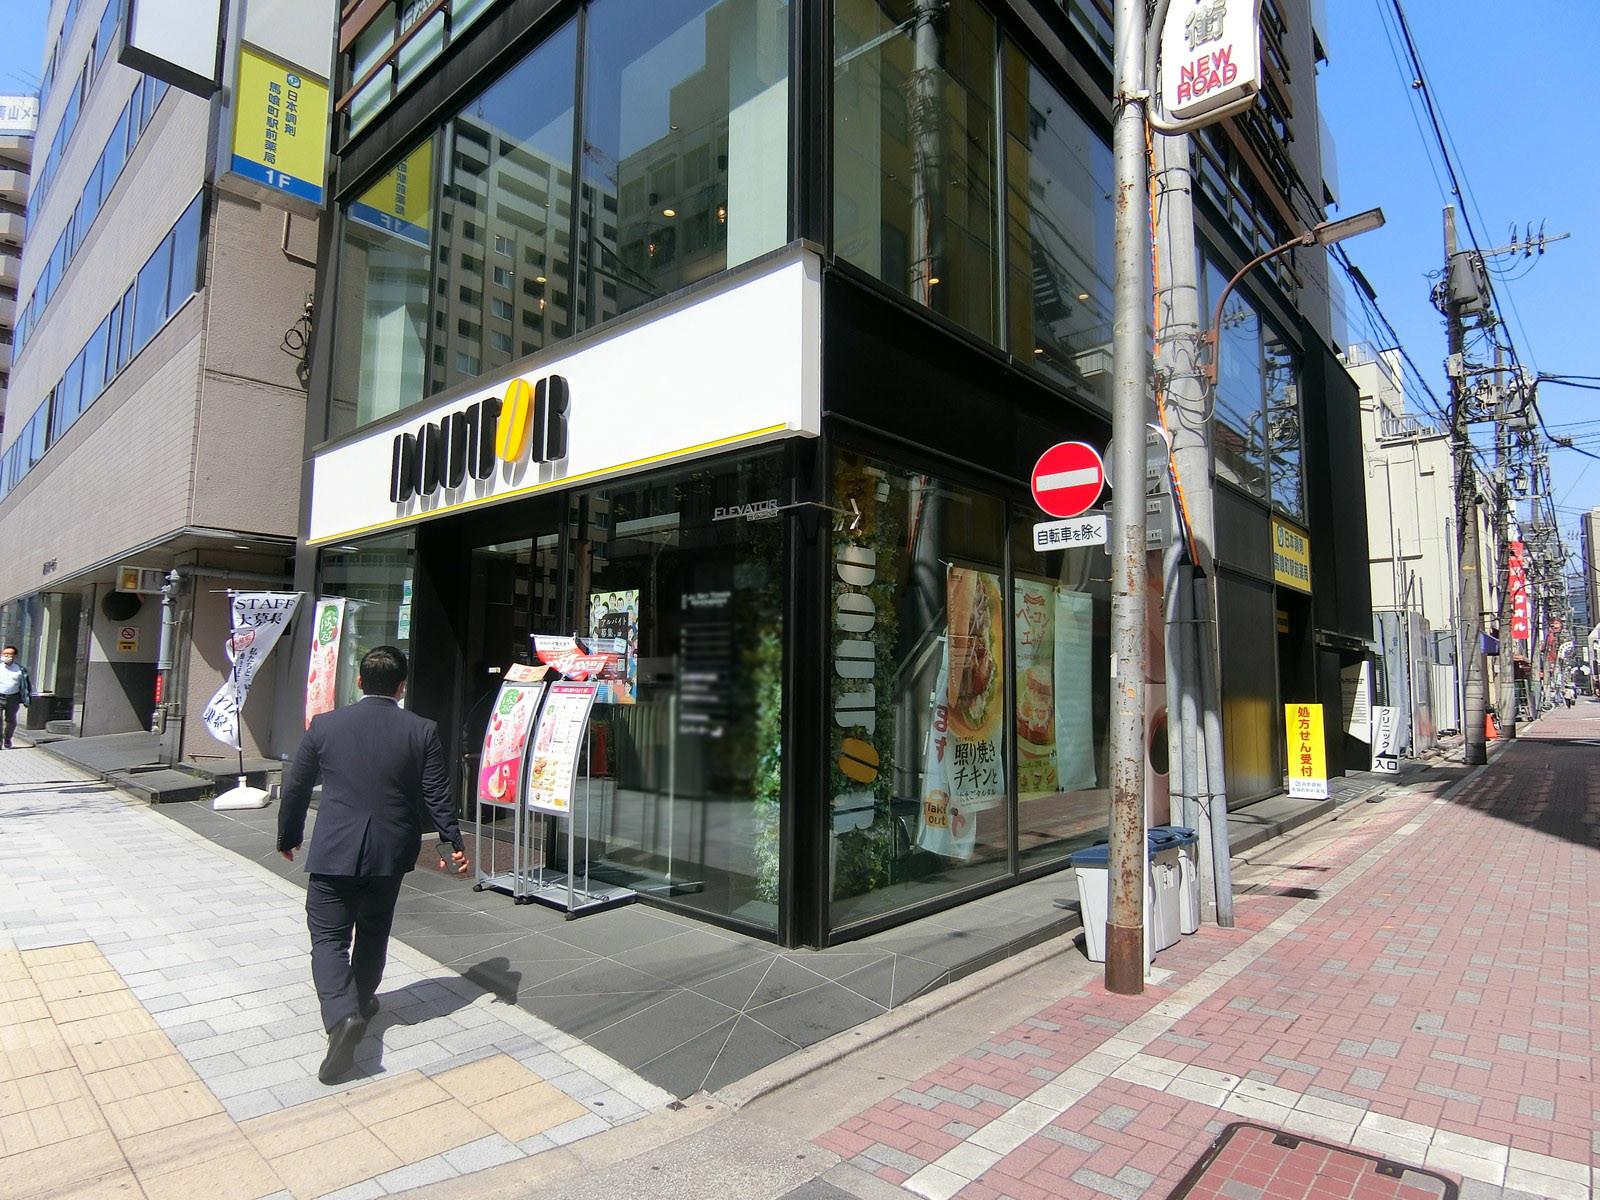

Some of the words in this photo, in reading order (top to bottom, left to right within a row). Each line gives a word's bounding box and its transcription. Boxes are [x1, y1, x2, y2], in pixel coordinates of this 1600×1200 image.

[1180, 44, 1232, 83] NEW
[1177, 62, 1237, 105] ROAD
[263, 81, 282, 165] 馬喰町駅前薬局
[284, 90, 298, 137] 日本調剤
[265, 169, 292, 189] 1F
[390, 374, 570, 504] DOUTOR
[713, 499, 778, 519] ELEVATOR
[1037, 523, 1102, 546] 自転車を除く
[1285, 530, 1304, 555] 日本調剤
[1273, 552, 1309, 582] 馬喰町駅前薬局
[235, 598, 296, 611] STAFF
[601, 617, 627, 627] アルバイト
[1381, 708, 1391, 748] クリニック
[954, 740, 996, 767] 照り焼き
[1297, 706, 1313, 777] 処方せん受付
[954, 765, 998, 790] チキンと
[1374, 759, 1398, 771] 入口
[928, 815, 946, 826] out
